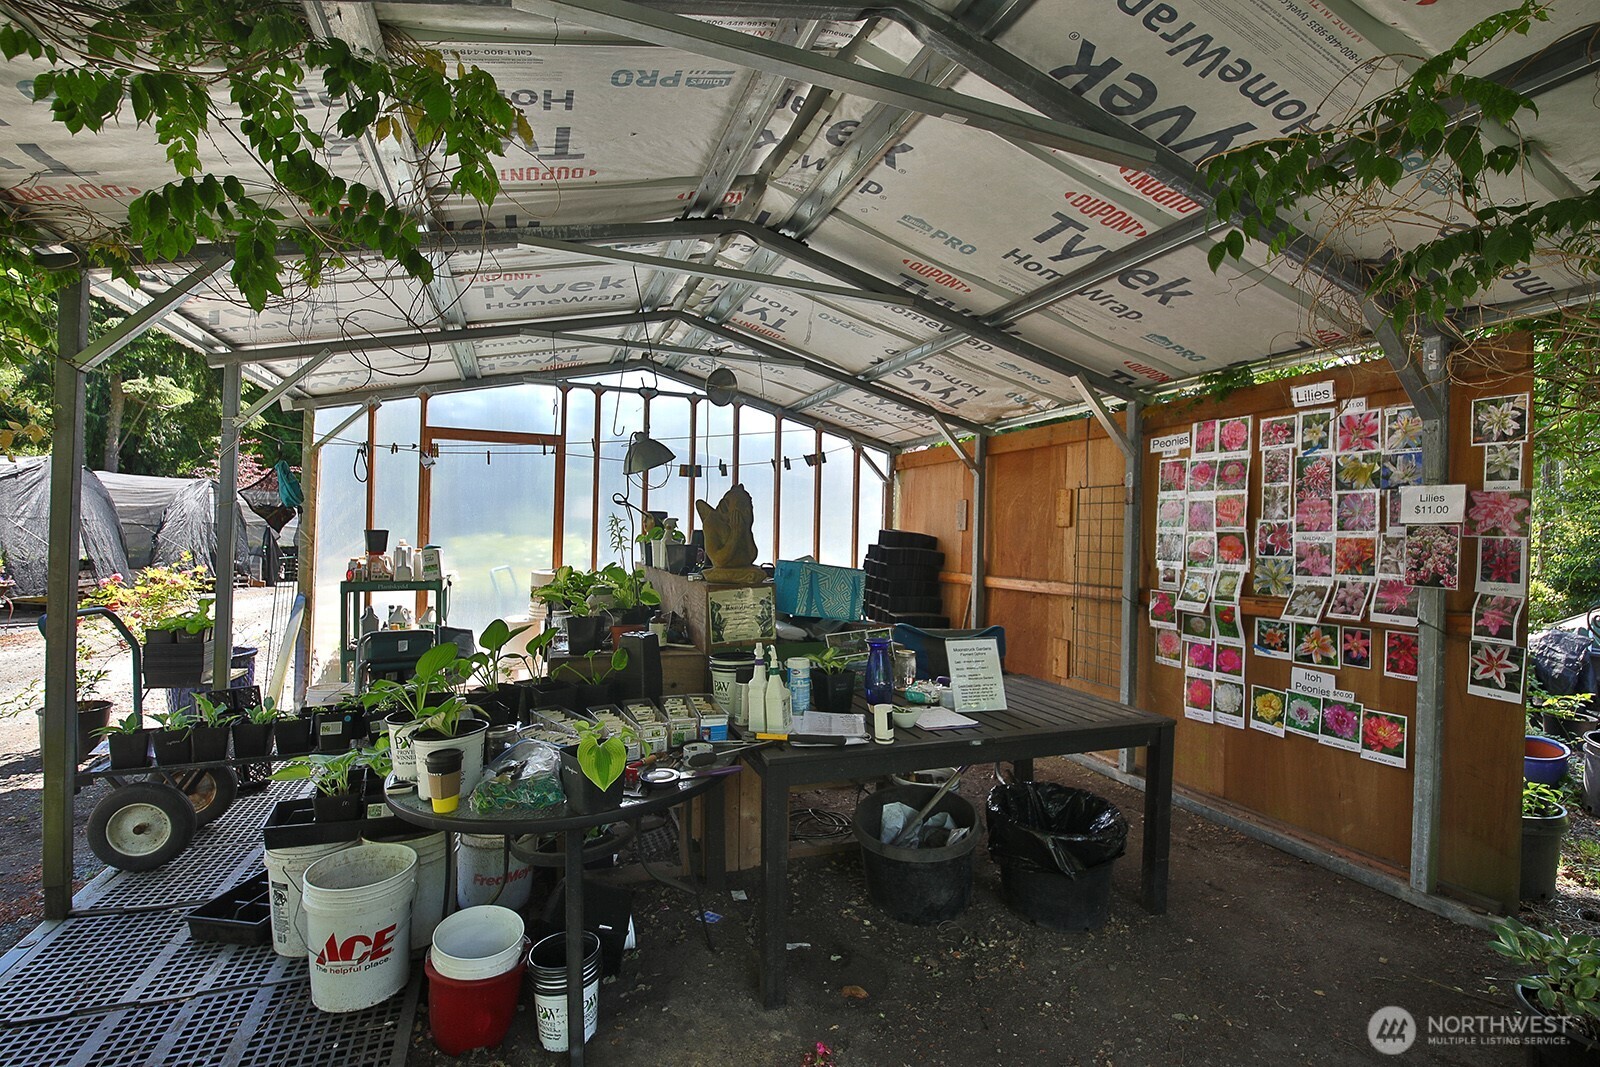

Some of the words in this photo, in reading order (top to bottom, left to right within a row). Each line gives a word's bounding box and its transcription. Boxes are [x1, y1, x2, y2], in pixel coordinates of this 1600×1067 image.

[610, 69, 684, 88] PRO
[1048, 38, 1258, 164] yvek
[501, 166, 584, 182] DUPONT
[1070, 194, 1144, 237] DUPONT
[930, 228, 978, 256] PRO
[1033, 210, 1193, 307] Tyek
[469, 272, 533, 284] DUPONT
[909, 261, 967, 291] DUPONT
[1001, 247, 1144, 322] HomWrap
[472, 276, 627, 301] Tyvek
[486, 293, 626, 310] HomeWrap
[1166, 344, 1207, 363] PRO
[1128, 362, 1173, 384] DUPON
[1296, 388, 1331, 403] Lilies
[1152, 436, 1189, 449] Peonies
[1419, 494, 1445, 503] Lilies
[1414, 505, 1449, 514] $11.00
[1304, 672, 1322, 683] Itoh
[1296, 682, 1331, 698] Peonies
[506, 866, 531, 885] Mey
[316, 923, 397, 966] ACE
[315, 964, 328, 973] The
[330, 965, 362, 975] helpful
[365, 957, 392, 971] place.
